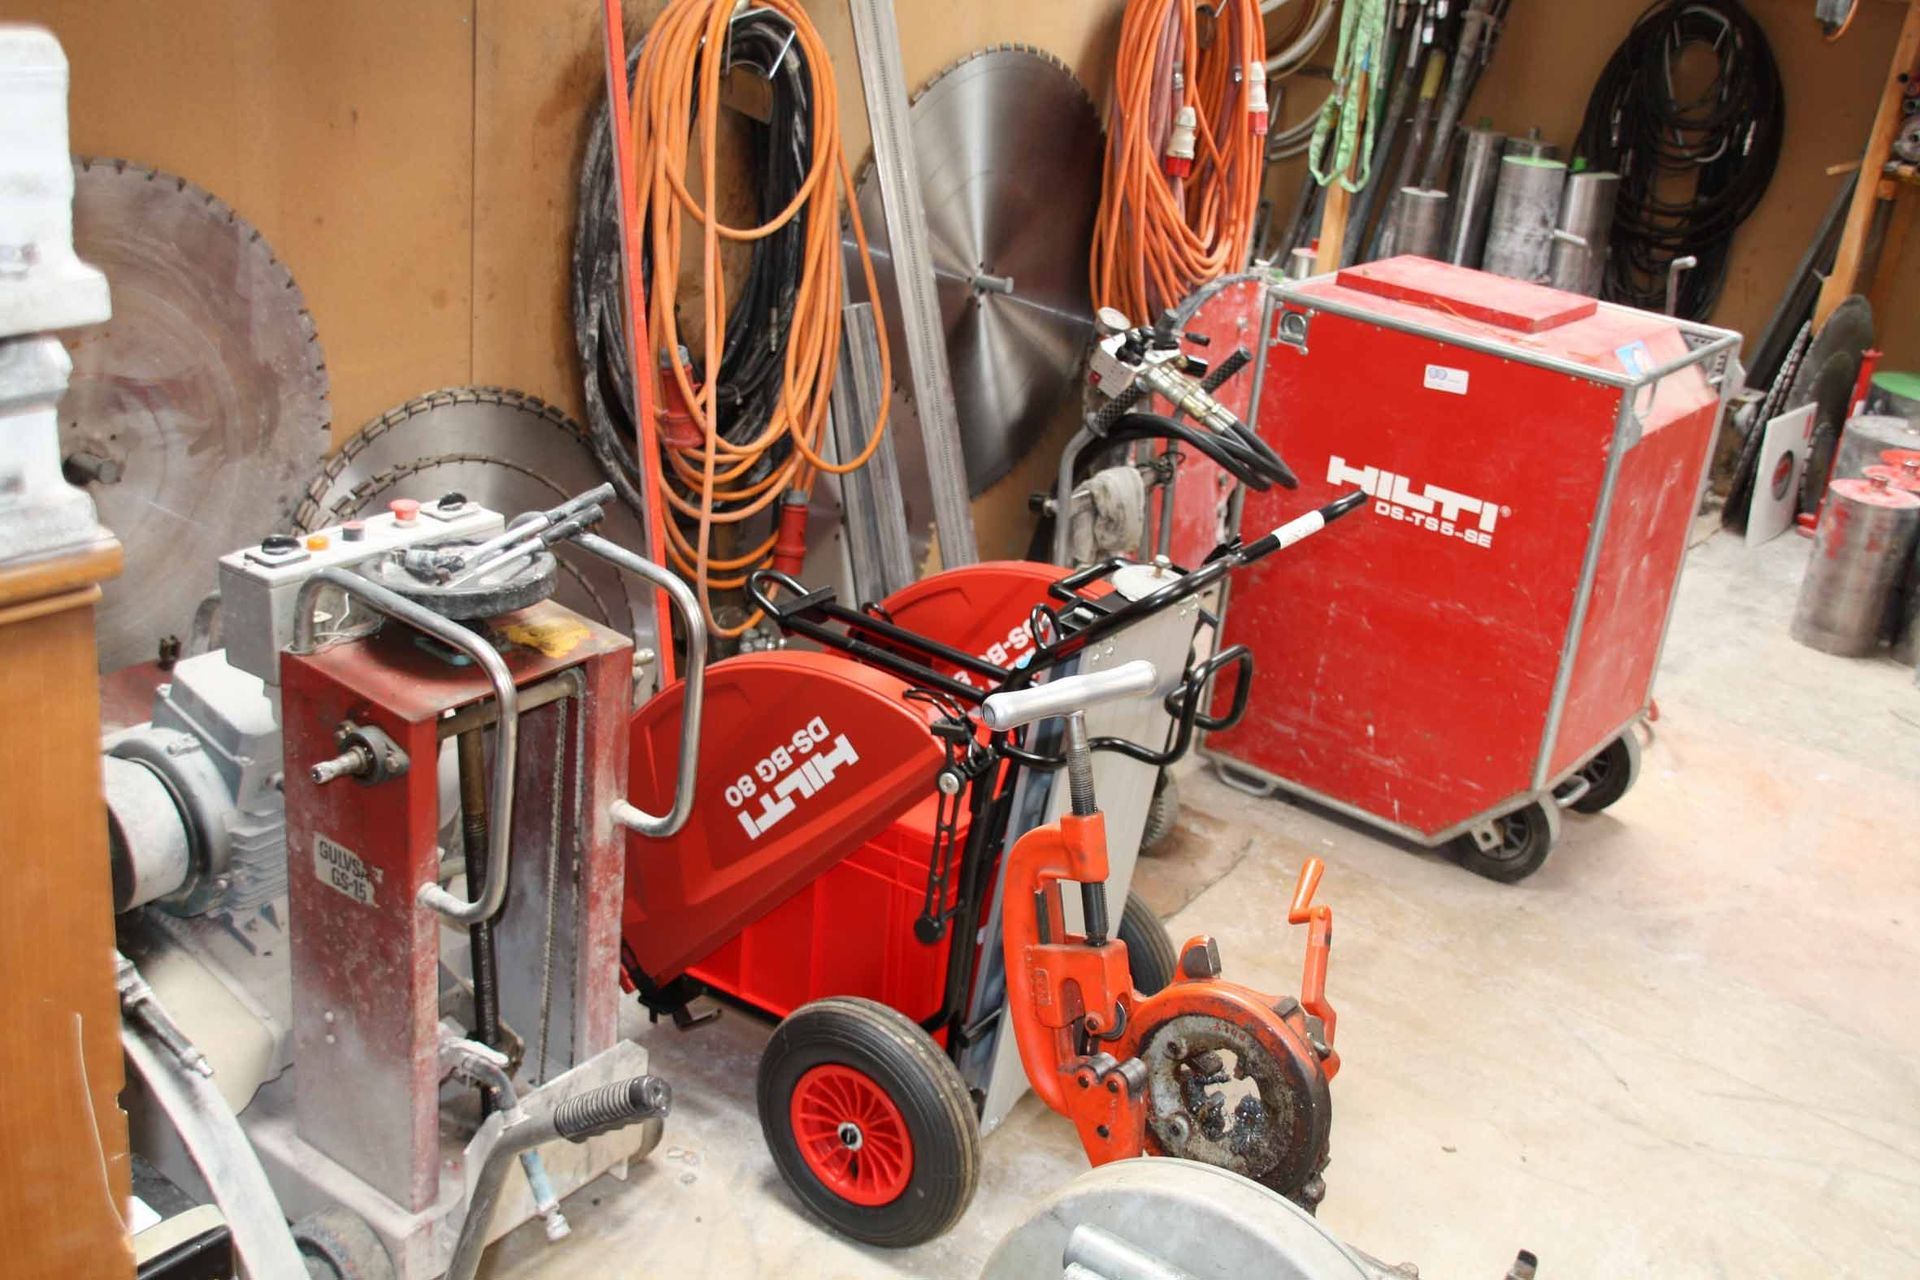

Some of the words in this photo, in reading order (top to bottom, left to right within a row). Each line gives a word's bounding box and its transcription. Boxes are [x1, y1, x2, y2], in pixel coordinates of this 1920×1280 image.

[1326, 455, 1499, 533] HILTI
[755, 715, 831, 782] DS-BG
[724, 774, 757, 808] 80
[737, 733, 860, 840] HILTI
[331, 866, 367, 901] GS-15
